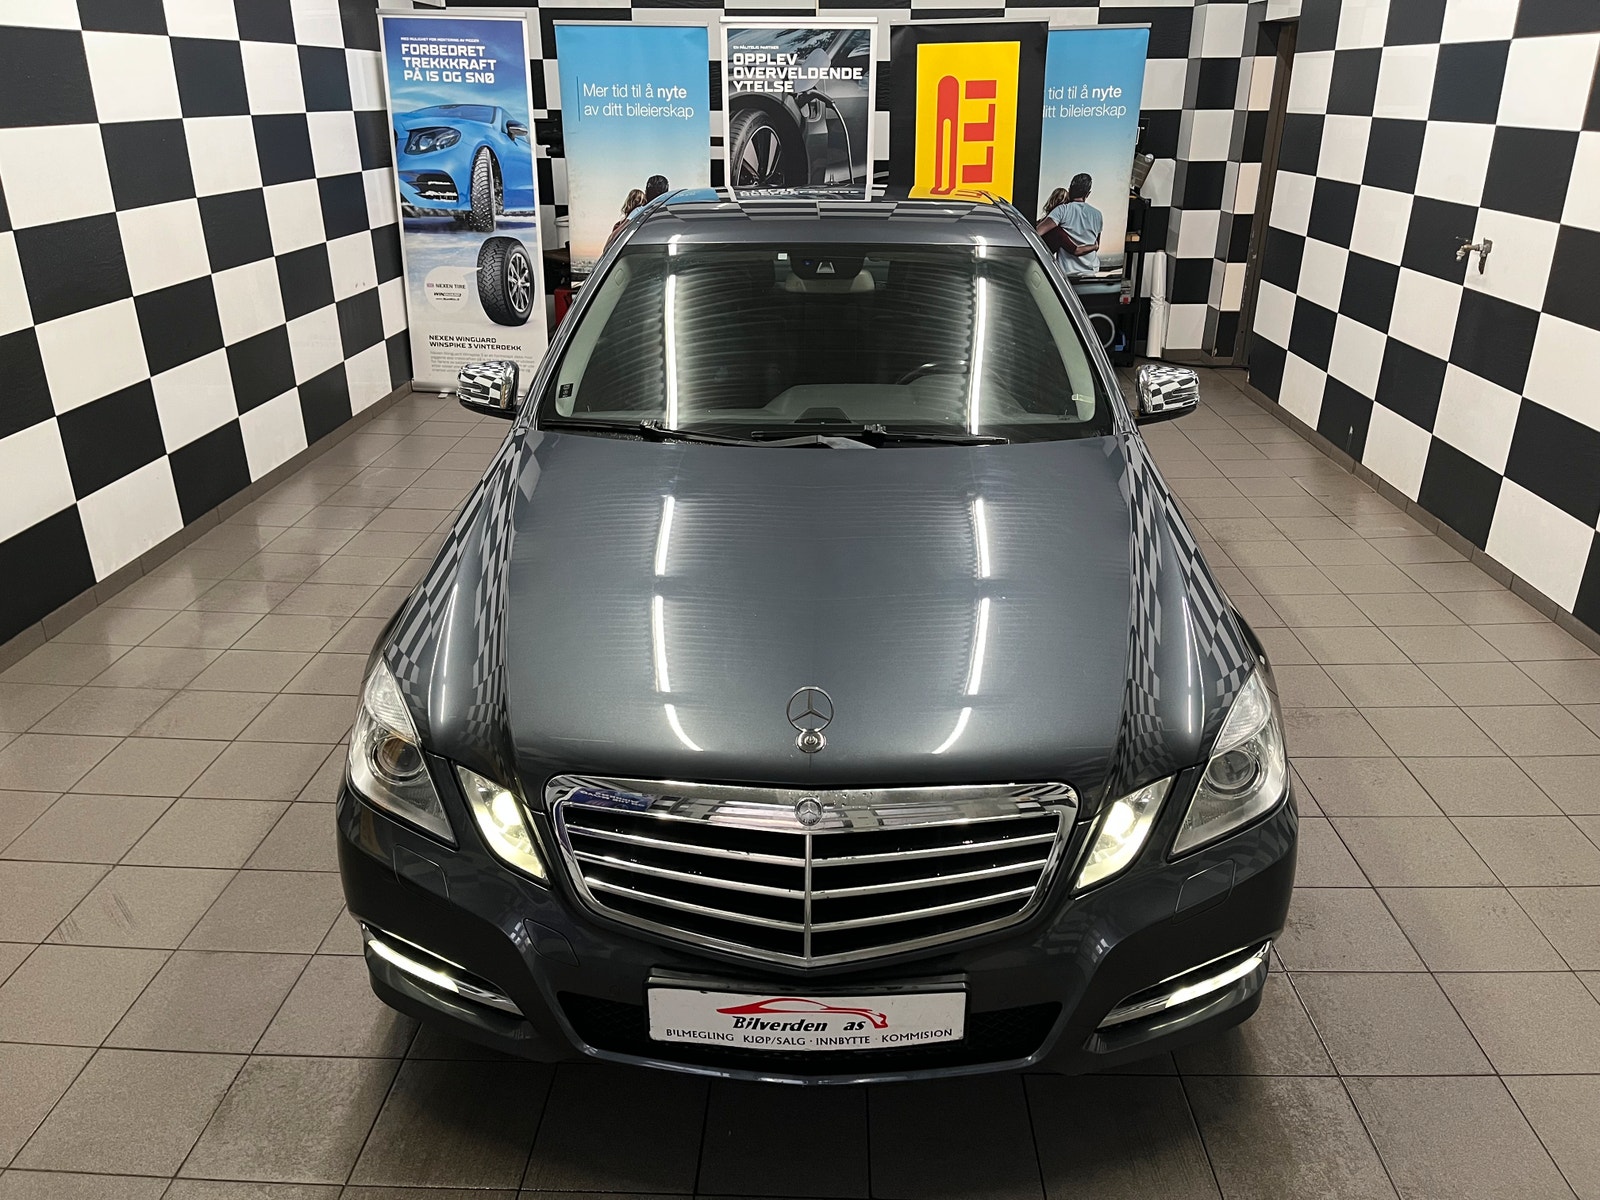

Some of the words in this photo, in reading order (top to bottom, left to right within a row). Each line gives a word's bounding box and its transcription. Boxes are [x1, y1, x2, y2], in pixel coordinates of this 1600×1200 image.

[401, 43, 486, 57] FORBEDRET
[402, 57, 497, 71] TREKKKRAFT
[733, 53, 798, 66] OPPLEV
[404, 67, 423, 81] PÅ
[426, 70, 439, 82] IS
[443, 71, 462, 83] OG
[465, 72, 495, 84] SNØ
[733, 67, 863, 80] OVERVELDENDE
[583, 83, 609, 98] Mer
[612, 84, 628, 98] tid
[631, 84, 642, 98] til
[645, 83, 654, 98] å
[657, 86, 688, 102] nyte
[733, 80, 794, 93] YTELSE
[1048, 86, 1064, 100] tid
[1067, 85, 1078, 99] til
[1080, 84, 1089, 99] å
[1092, 85, 1122, 102] nyte
[584, 104, 599, 116] av
[602, 102, 623, 117] ditt
[626, 103, 694, 120] bileierskap
[1060, 103, 1127, 119] bileierskap
[429, 334, 454, 342] NEXEN
[455, 336, 497, 344] WINGUARD
[429, 341, 467, 349] WINSPIKE
[473, 343, 522, 351] VINTERDEKK
[732, 1015, 828, 1032] Bilverden
[842, 1018, 866, 1031] as
[665, 1028, 735, 1042] BILMEGLING
[743, 1034, 806, 1046] KJØP/SALG
[815, 1035, 871, 1046] INNBYTTE
[881, 1028, 953, 1043] KOMMISION
